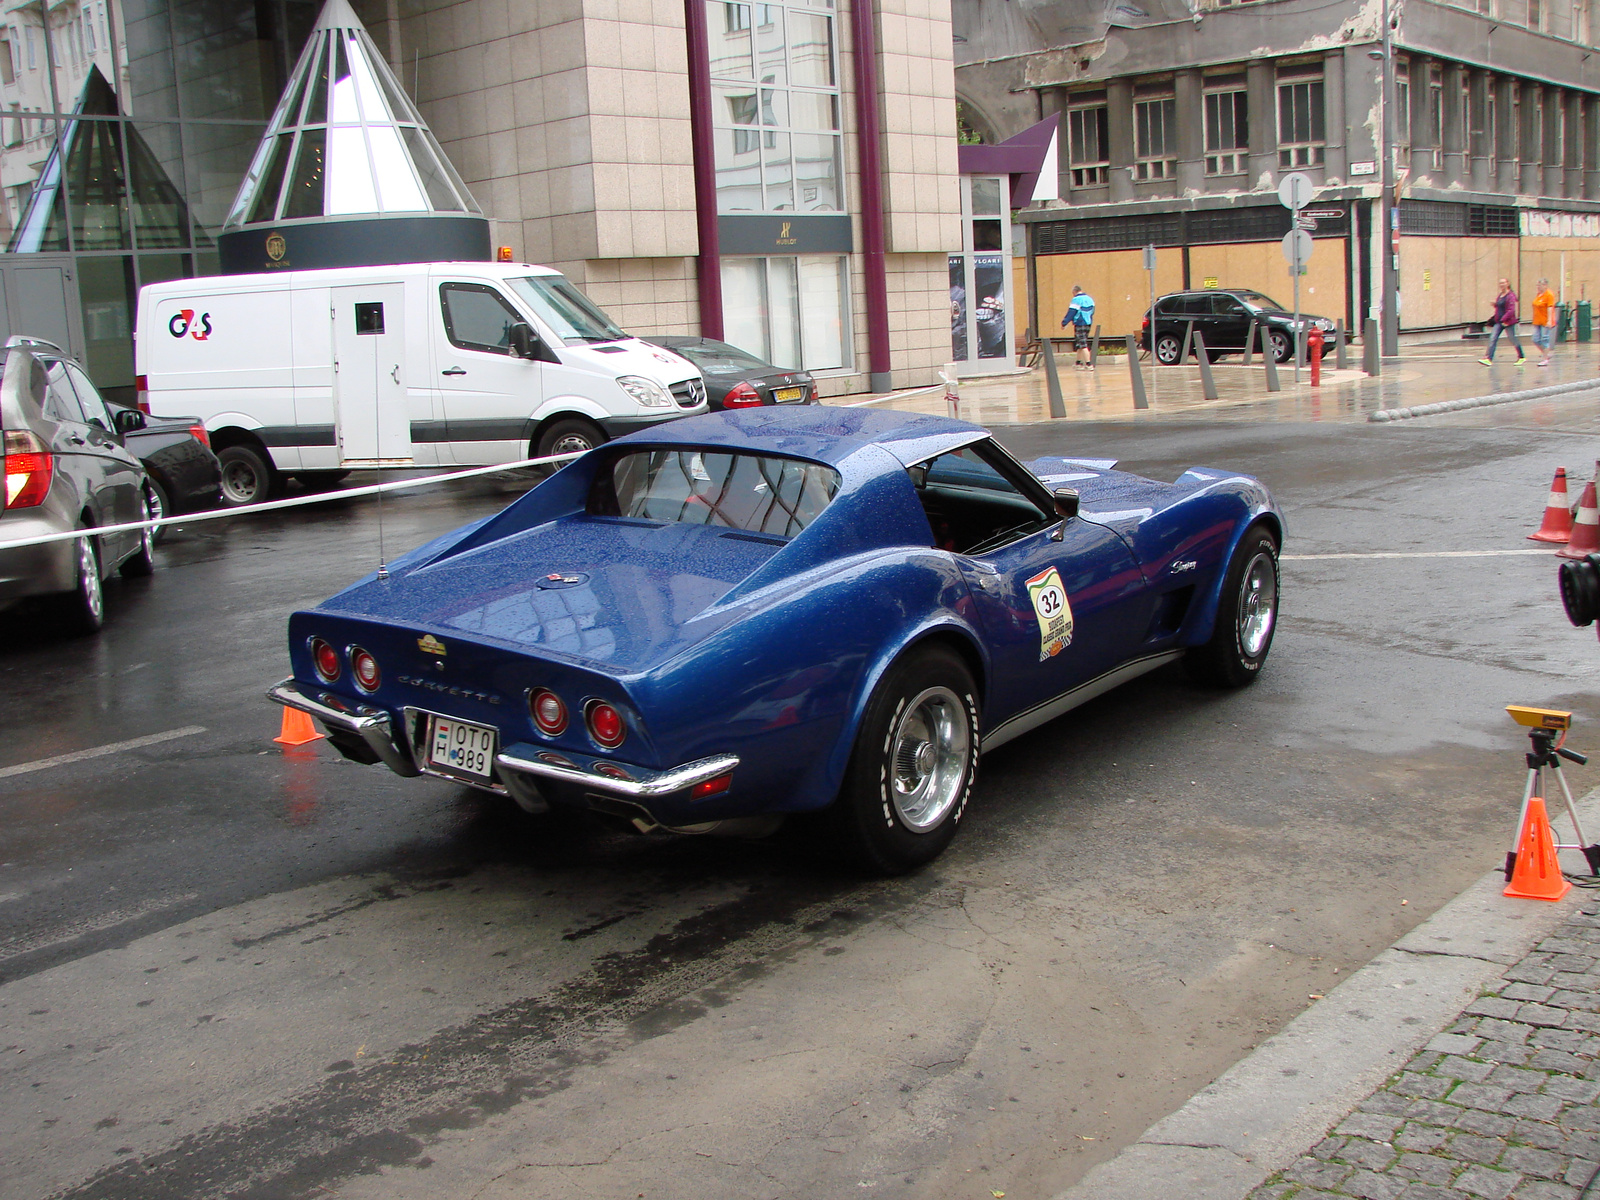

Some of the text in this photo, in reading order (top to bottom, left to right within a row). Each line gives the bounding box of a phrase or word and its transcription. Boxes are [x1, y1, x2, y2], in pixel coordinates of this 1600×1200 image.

[169, 309, 212, 341] G4S
[1041, 590, 1060, 614] 32
[1048, 614, 1064, 631] BUDAPEST
[1043, 631, 1055, 644] CLASSIC
[1054, 625, 1065, 638] GRAND
[436, 741, 447, 757] H
[456, 747, 485, 772] 989
